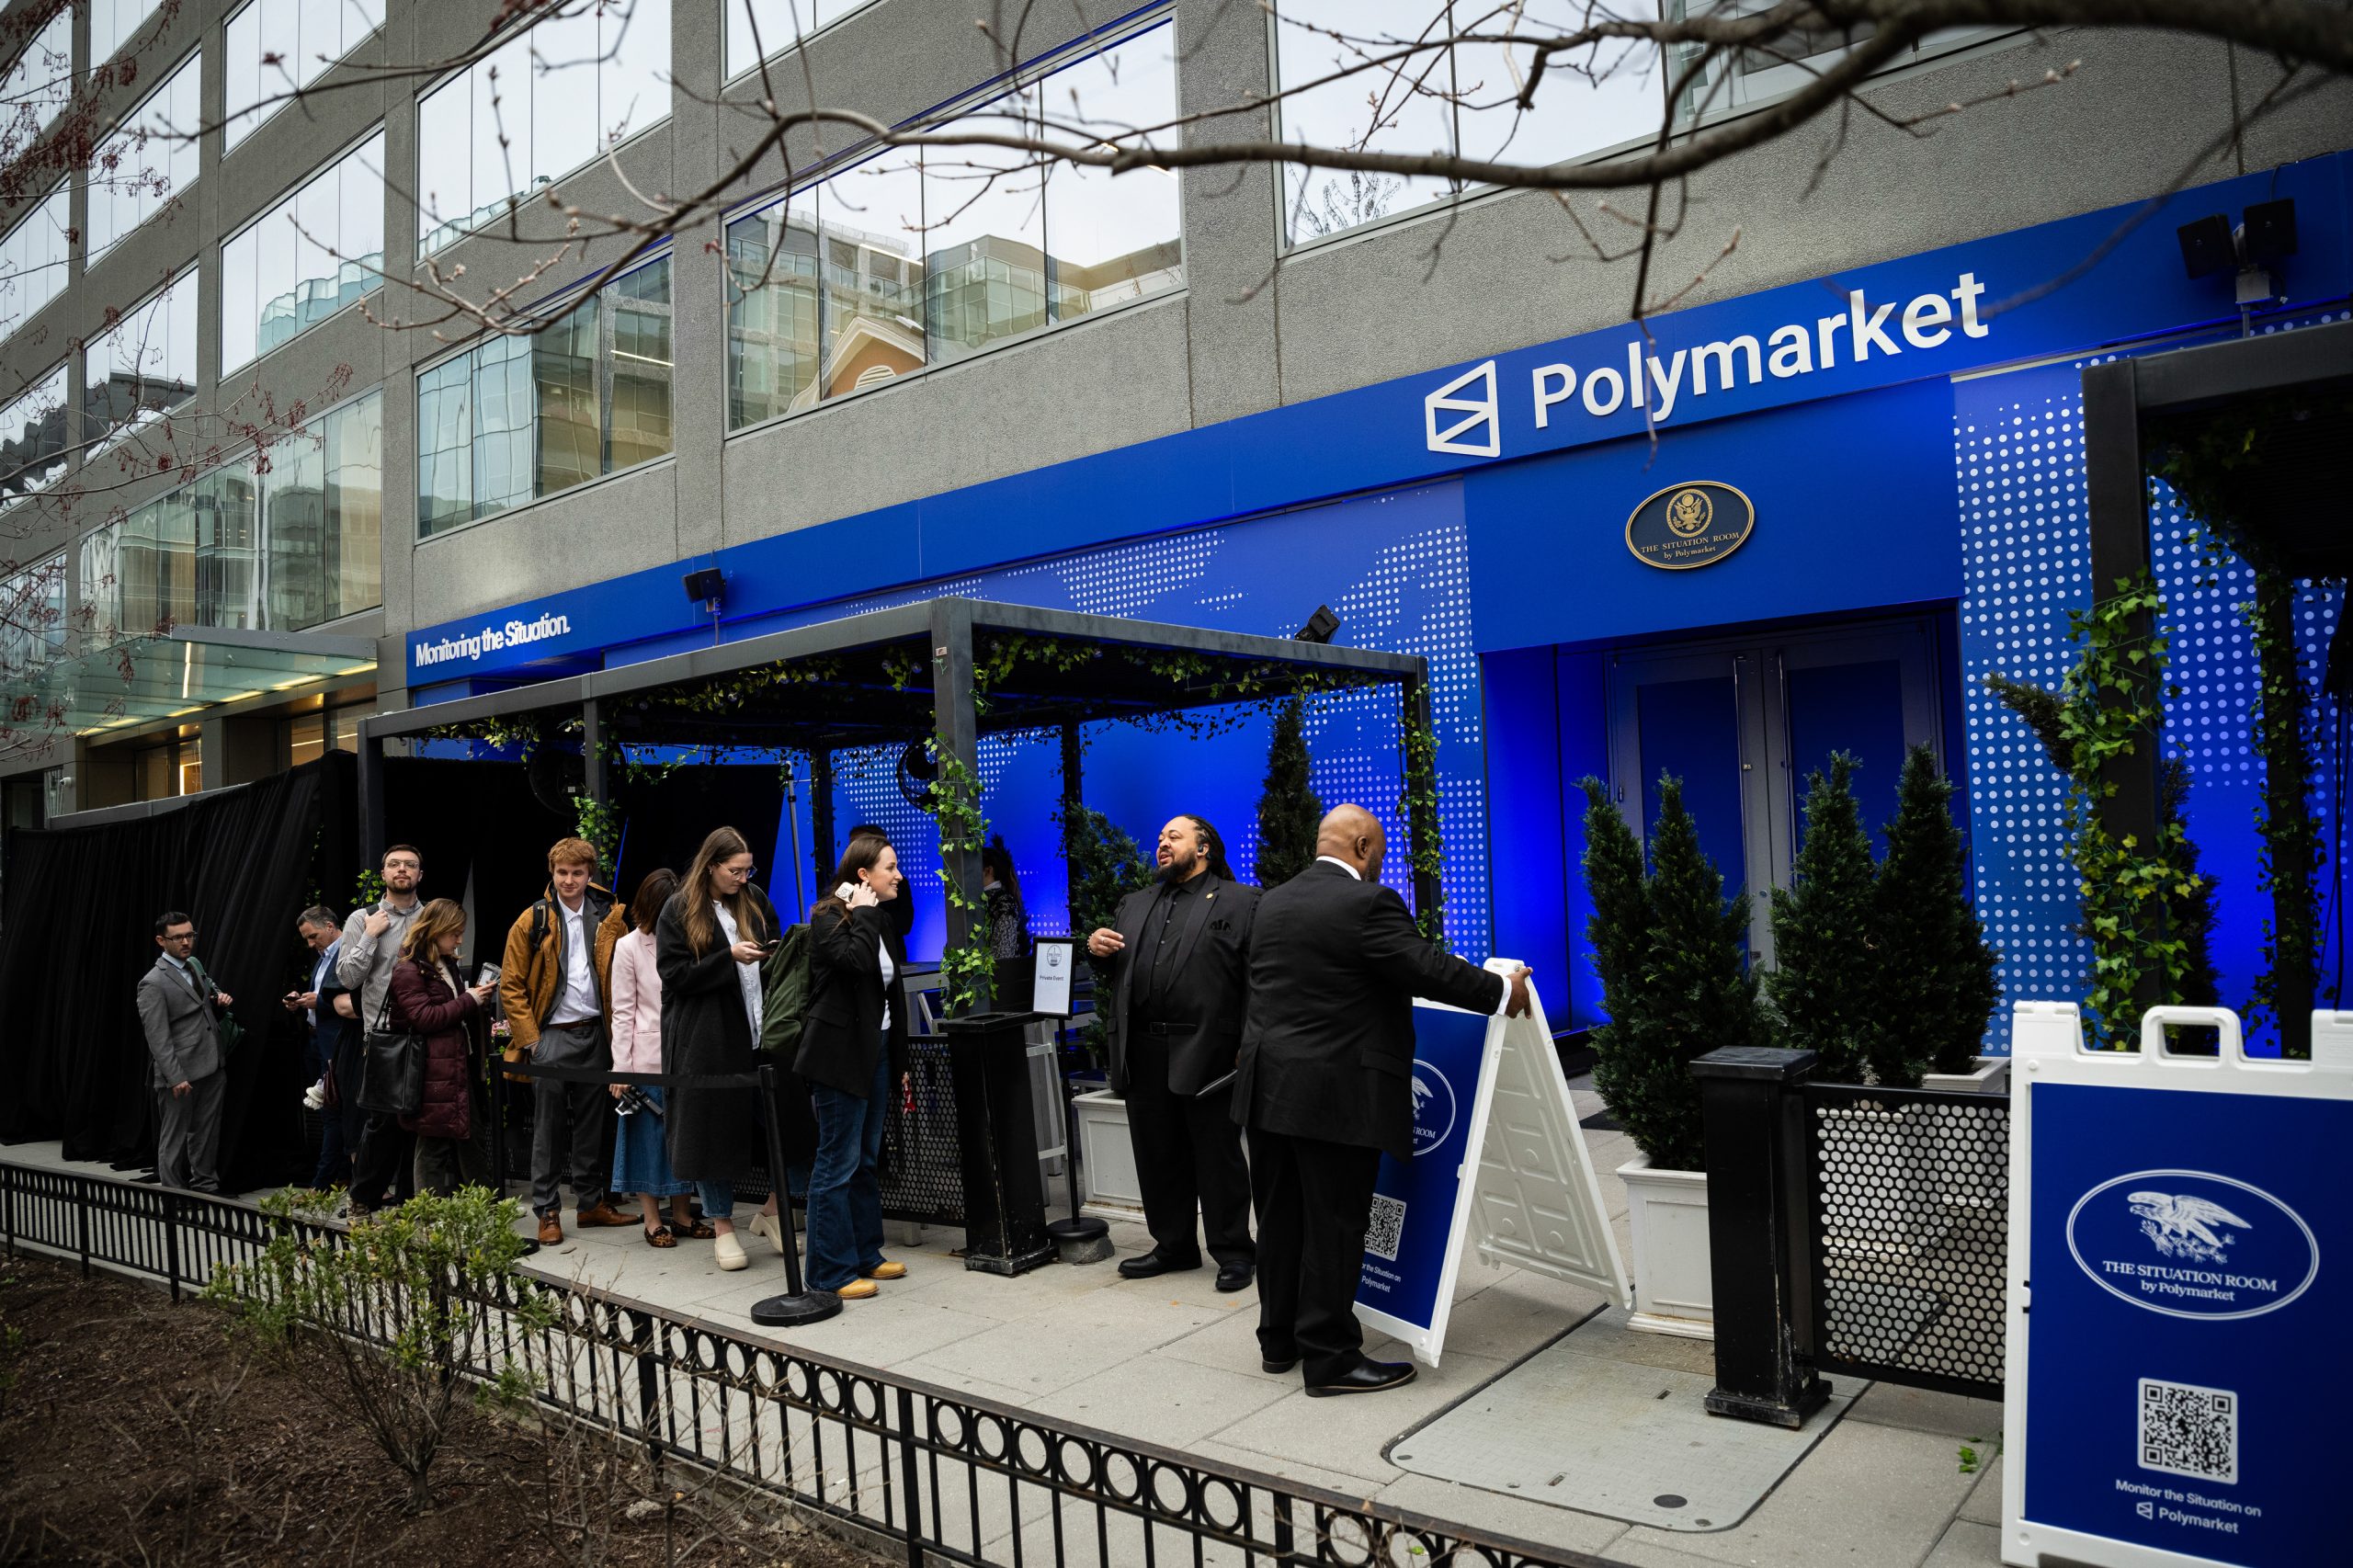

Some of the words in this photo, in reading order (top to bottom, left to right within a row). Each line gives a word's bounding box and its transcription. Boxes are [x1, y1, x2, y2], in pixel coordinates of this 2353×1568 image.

[1532, 272, 1989, 429] Polymarket
[1641, 544, 1659, 553] THE
[1662, 537, 1709, 550] SITUATION
[1712, 532, 1740, 542] ROOM
[1664, 551, 1672, 560] by
[1676, 546, 1716, 558] Polymarket
[415, 633, 481, 667] Monitoring
[482, 627, 504, 653] the
[505, 612, 571, 647] Situation.
[1415, 1127, 1436, 1139] ROOM
[1366, 1263, 1374, 1272] the
[1374, 1266, 1394, 1279] Situation
[2102, 1260, 2135, 1275] THE
[2137, 1265, 2222, 1285] SITUATION
[2224, 1275, 2278, 1292] ROOM
[1361, 1275, 1391, 1293] Polymarket
[2141, 1279, 2157, 1294] by
[2158, 1283, 2235, 1301] Polymarket
[2116, 1479, 2162, 1498] Monitor
[2164, 1489, 2184, 1503] the
[2186, 1493, 2243, 1514] Situation
[2245, 1506, 2262, 1517] on
[2158, 1506, 2239, 1534] Polymarket
